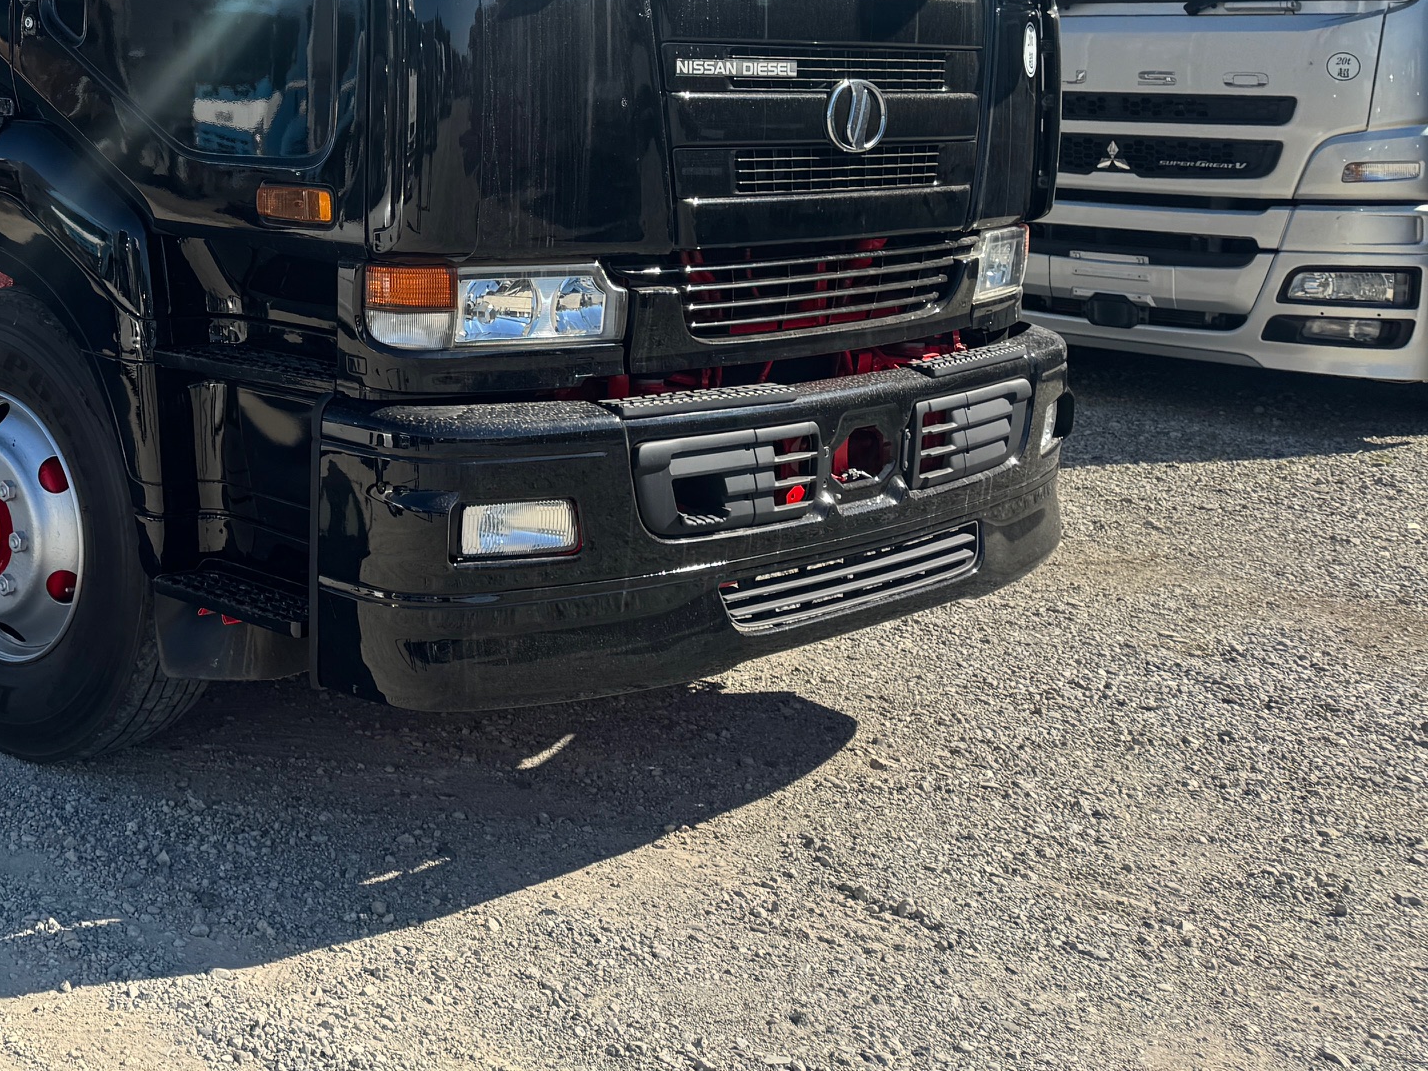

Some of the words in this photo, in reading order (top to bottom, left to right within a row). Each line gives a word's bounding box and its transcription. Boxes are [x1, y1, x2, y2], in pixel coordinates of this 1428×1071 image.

[1335, 57, 1351, 65] 20t
[676, 60, 737, 75] NISSAN
[742, 62, 797, 76] DIESEL
